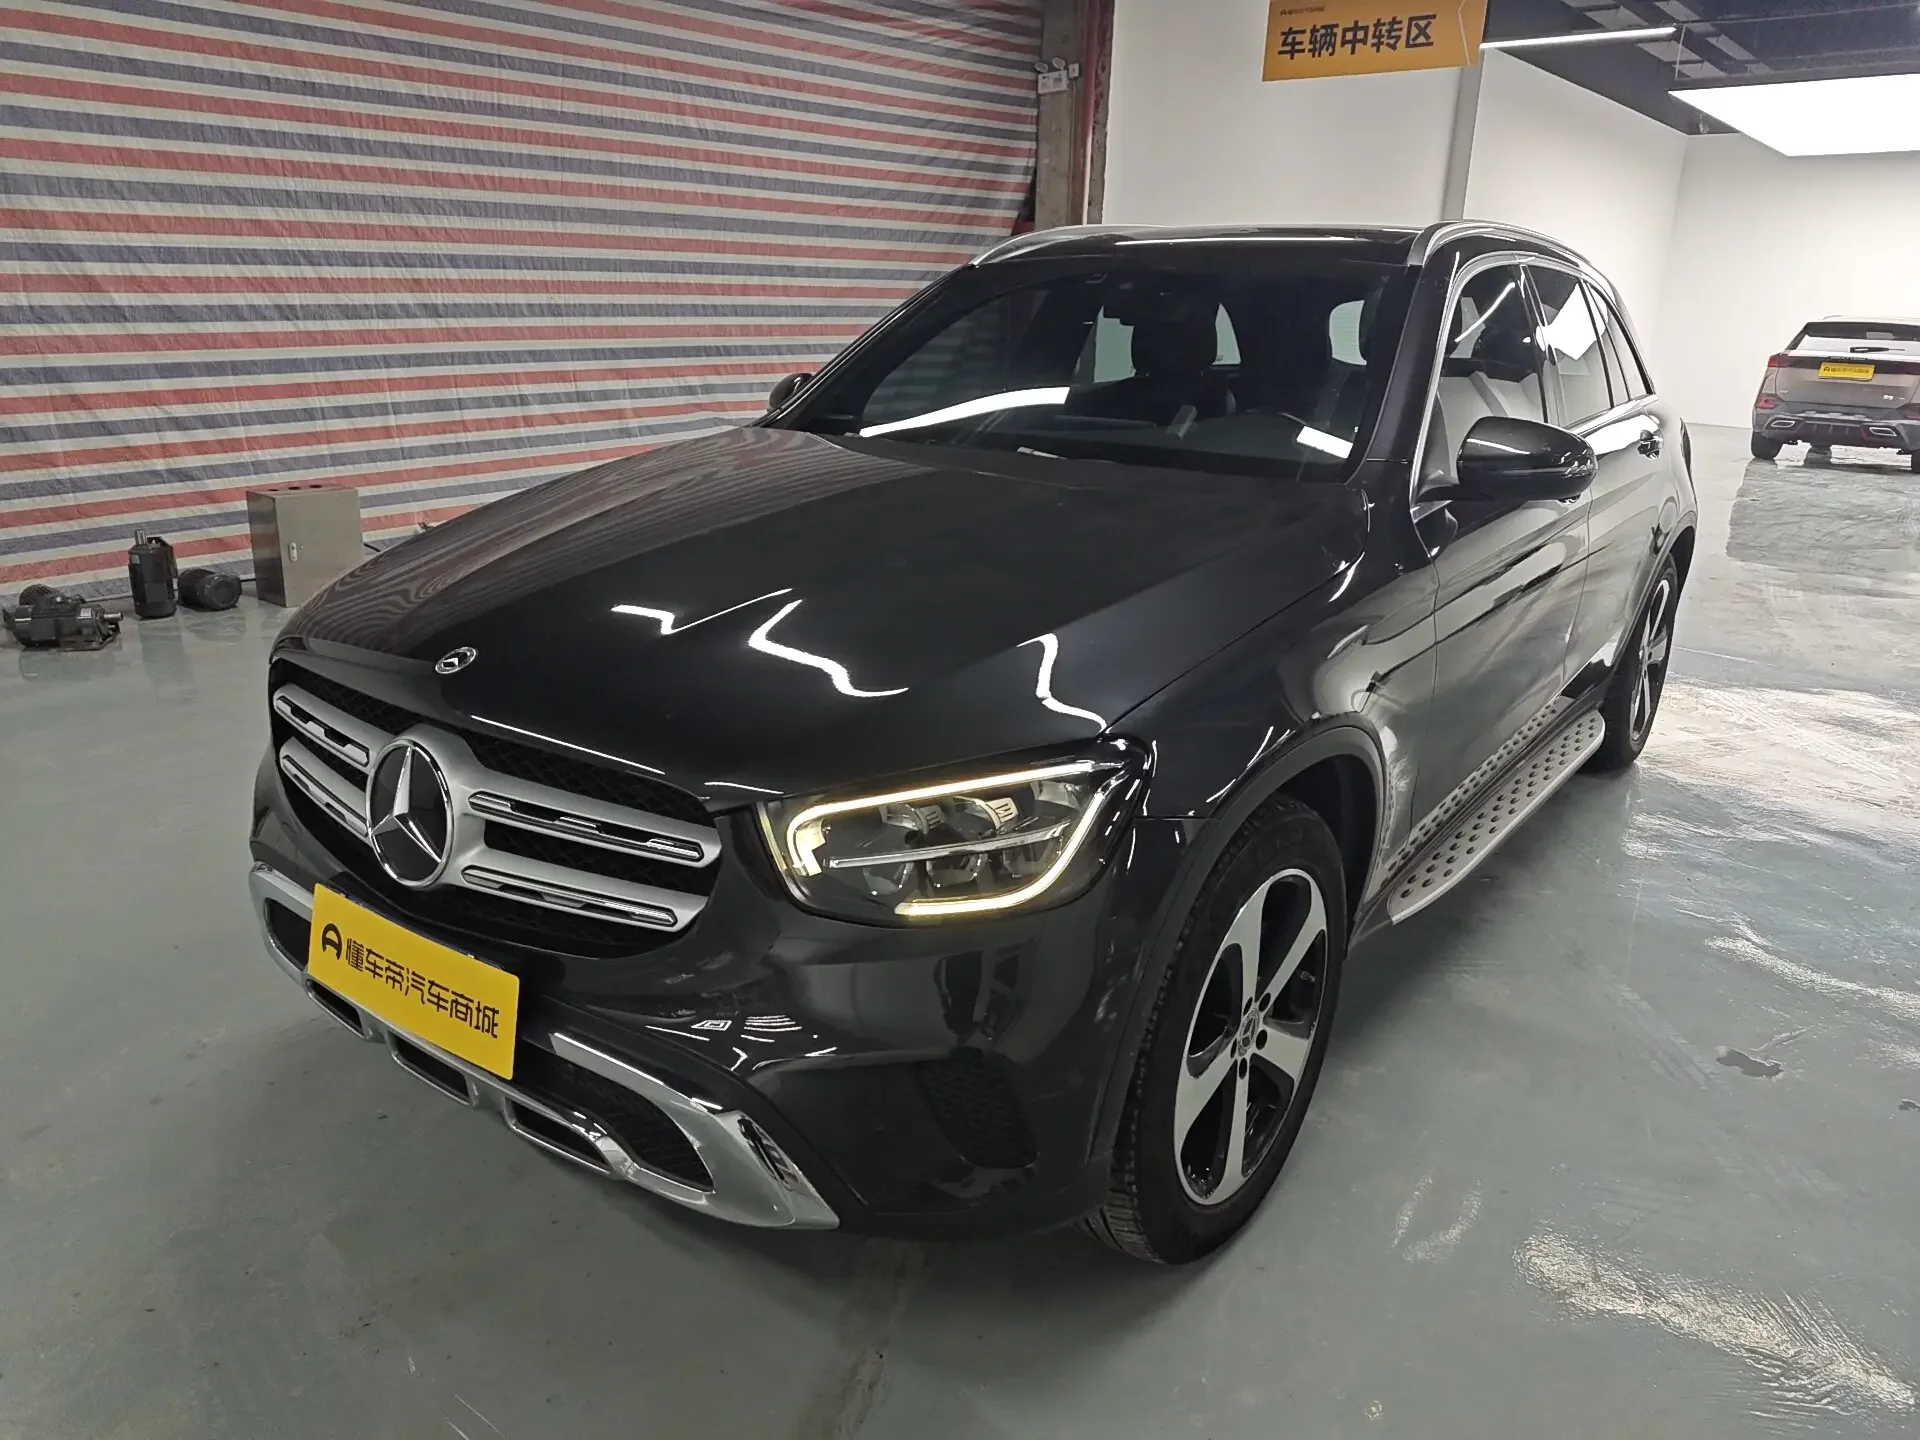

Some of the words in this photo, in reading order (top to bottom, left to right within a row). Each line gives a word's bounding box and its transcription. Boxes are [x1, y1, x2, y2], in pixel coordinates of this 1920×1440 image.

[1278, 14, 1437, 60] 车辆中转区
[345, 937, 500, 1039] 懂车帝汽车商城
